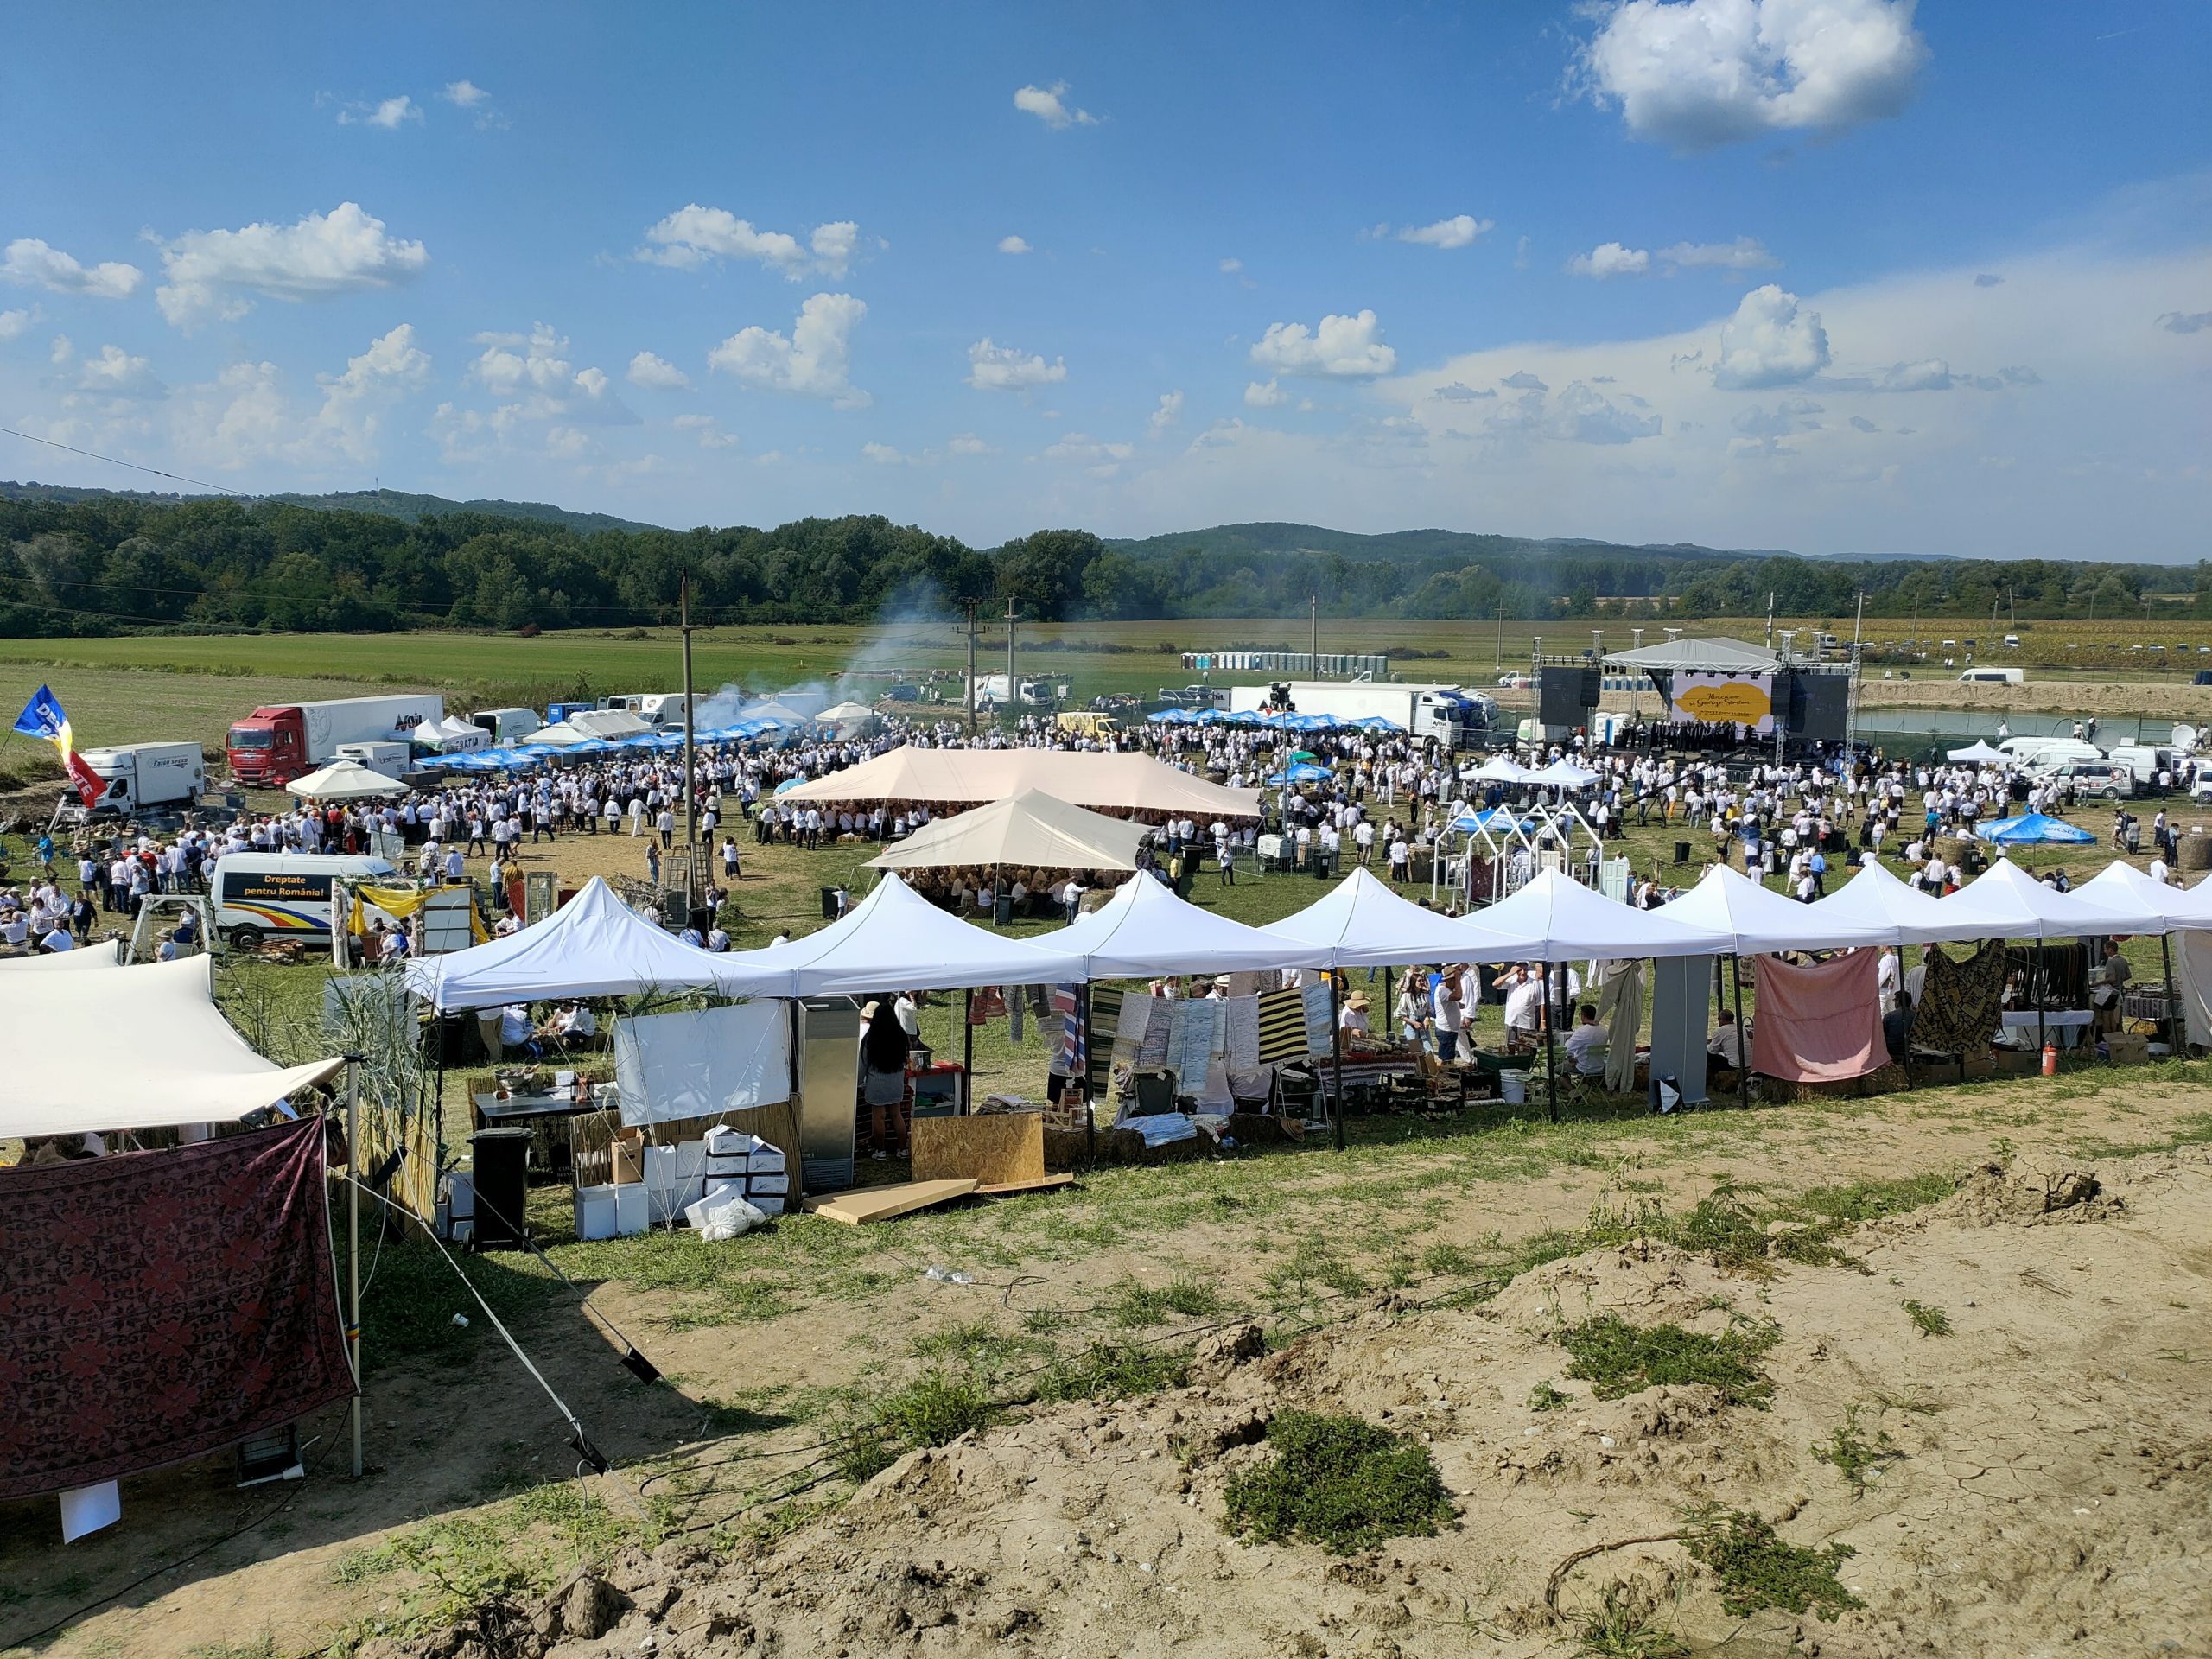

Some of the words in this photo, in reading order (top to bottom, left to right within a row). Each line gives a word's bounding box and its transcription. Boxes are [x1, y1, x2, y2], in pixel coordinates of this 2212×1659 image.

[264, 874, 307, 885] Dreptate
[244, 887, 276, 896] pentru
[278, 887, 325, 897] România!
